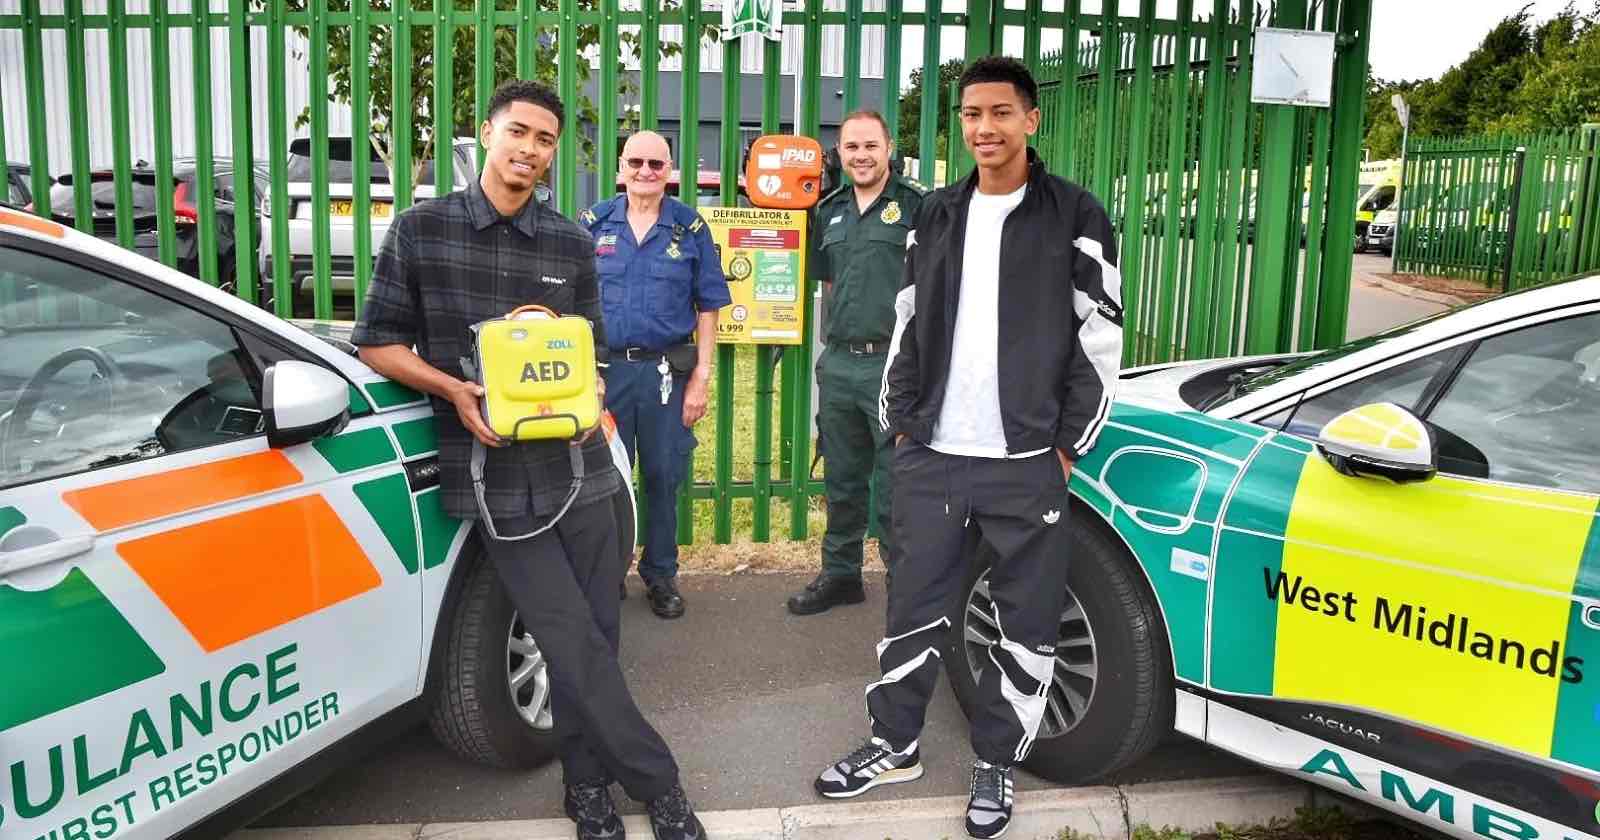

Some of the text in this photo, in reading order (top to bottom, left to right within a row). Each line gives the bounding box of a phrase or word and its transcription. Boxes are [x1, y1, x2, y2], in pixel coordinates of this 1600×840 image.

[713, 209, 790, 220] DEFIBRILLATOR &
[727, 324, 744, 332] 999
[520, 361, 570, 383] AED
[1263, 567, 1584, 684] West Midlands
[0, 643, 299, 828] ULANCE
[1302, 713, 1382, 744] JAGUAR
[148, 692, 340, 811] RESPONDER
